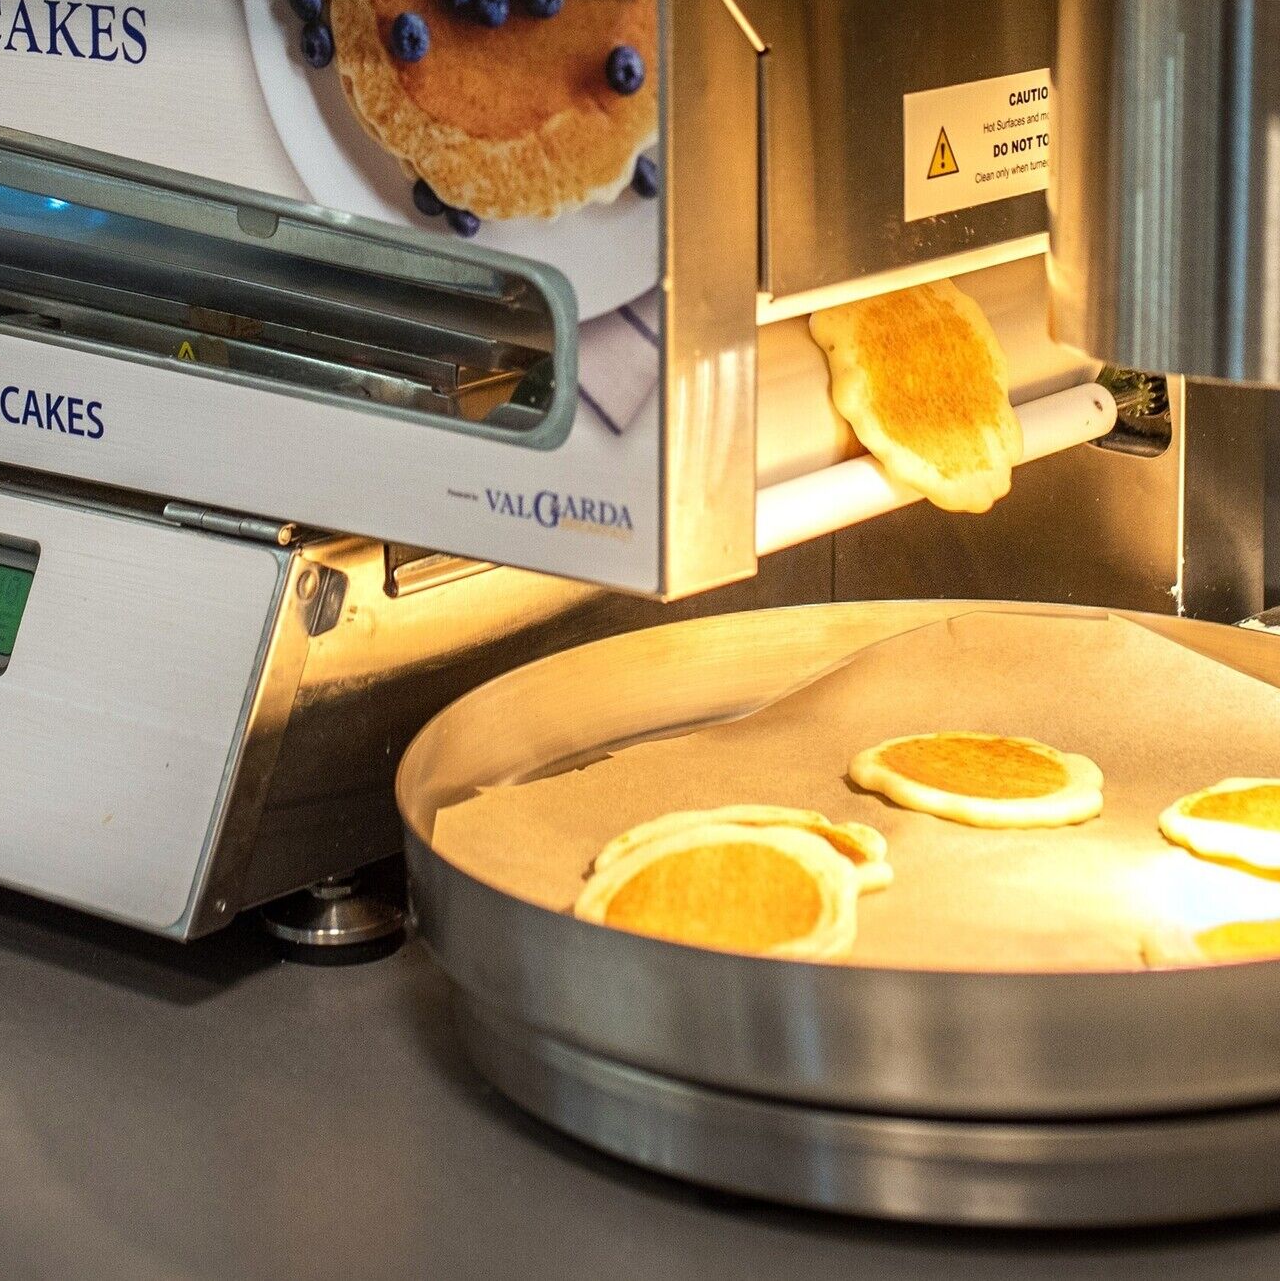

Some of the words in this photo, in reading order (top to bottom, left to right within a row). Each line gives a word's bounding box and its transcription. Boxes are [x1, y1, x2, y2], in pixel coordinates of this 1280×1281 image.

[1009, 87, 1048, 106] CAUTIO
[983, 122, 995, 134] Hot
[997, 117, 1025, 131] Surfaces
[1027, 114, 1039, 123] and
[994, 143, 1008, 157] DO
[1012, 137, 1033, 153] NOT
[1036, 134, 1049, 147] TO
[975, 171, 994, 183] Clean
[996, 167, 1009, 179] only
[1011, 163, 1028, 174] when
